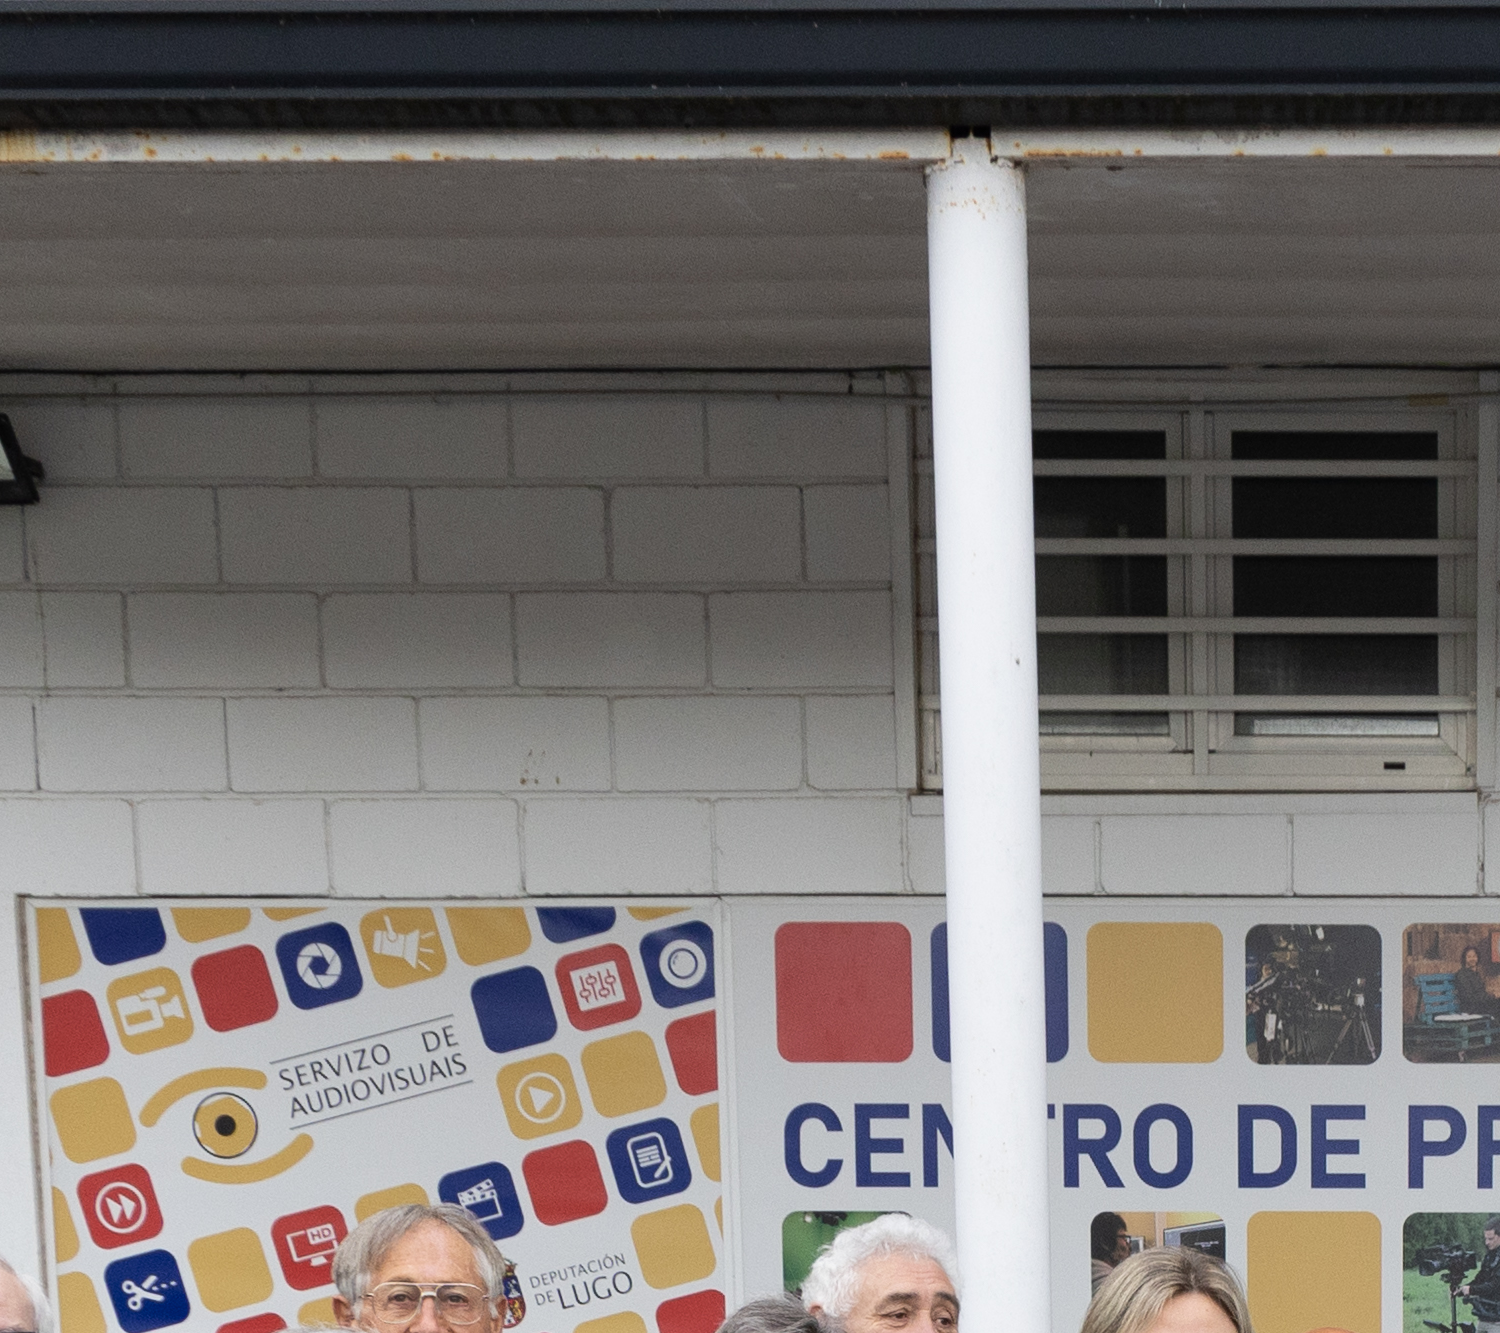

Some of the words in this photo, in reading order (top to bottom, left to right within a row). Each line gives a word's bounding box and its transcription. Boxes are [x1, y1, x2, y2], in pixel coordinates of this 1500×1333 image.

[279, 1043, 391, 1091] SERVIZO
[421, 1025, 459, 1053] DE
[290, 1053, 467, 1119] AUDIOVISUAIS
[784, 1102, 1194, 1189] CENRO
[1237, 1103, 1367, 1188] DE
[310, 1227, 331, 1241] HD
[529, 1253, 626, 1289] DEPUTACIÓN
[534, 1290, 555, 1306] DE
[557, 1271, 633, 1310] LUGO
